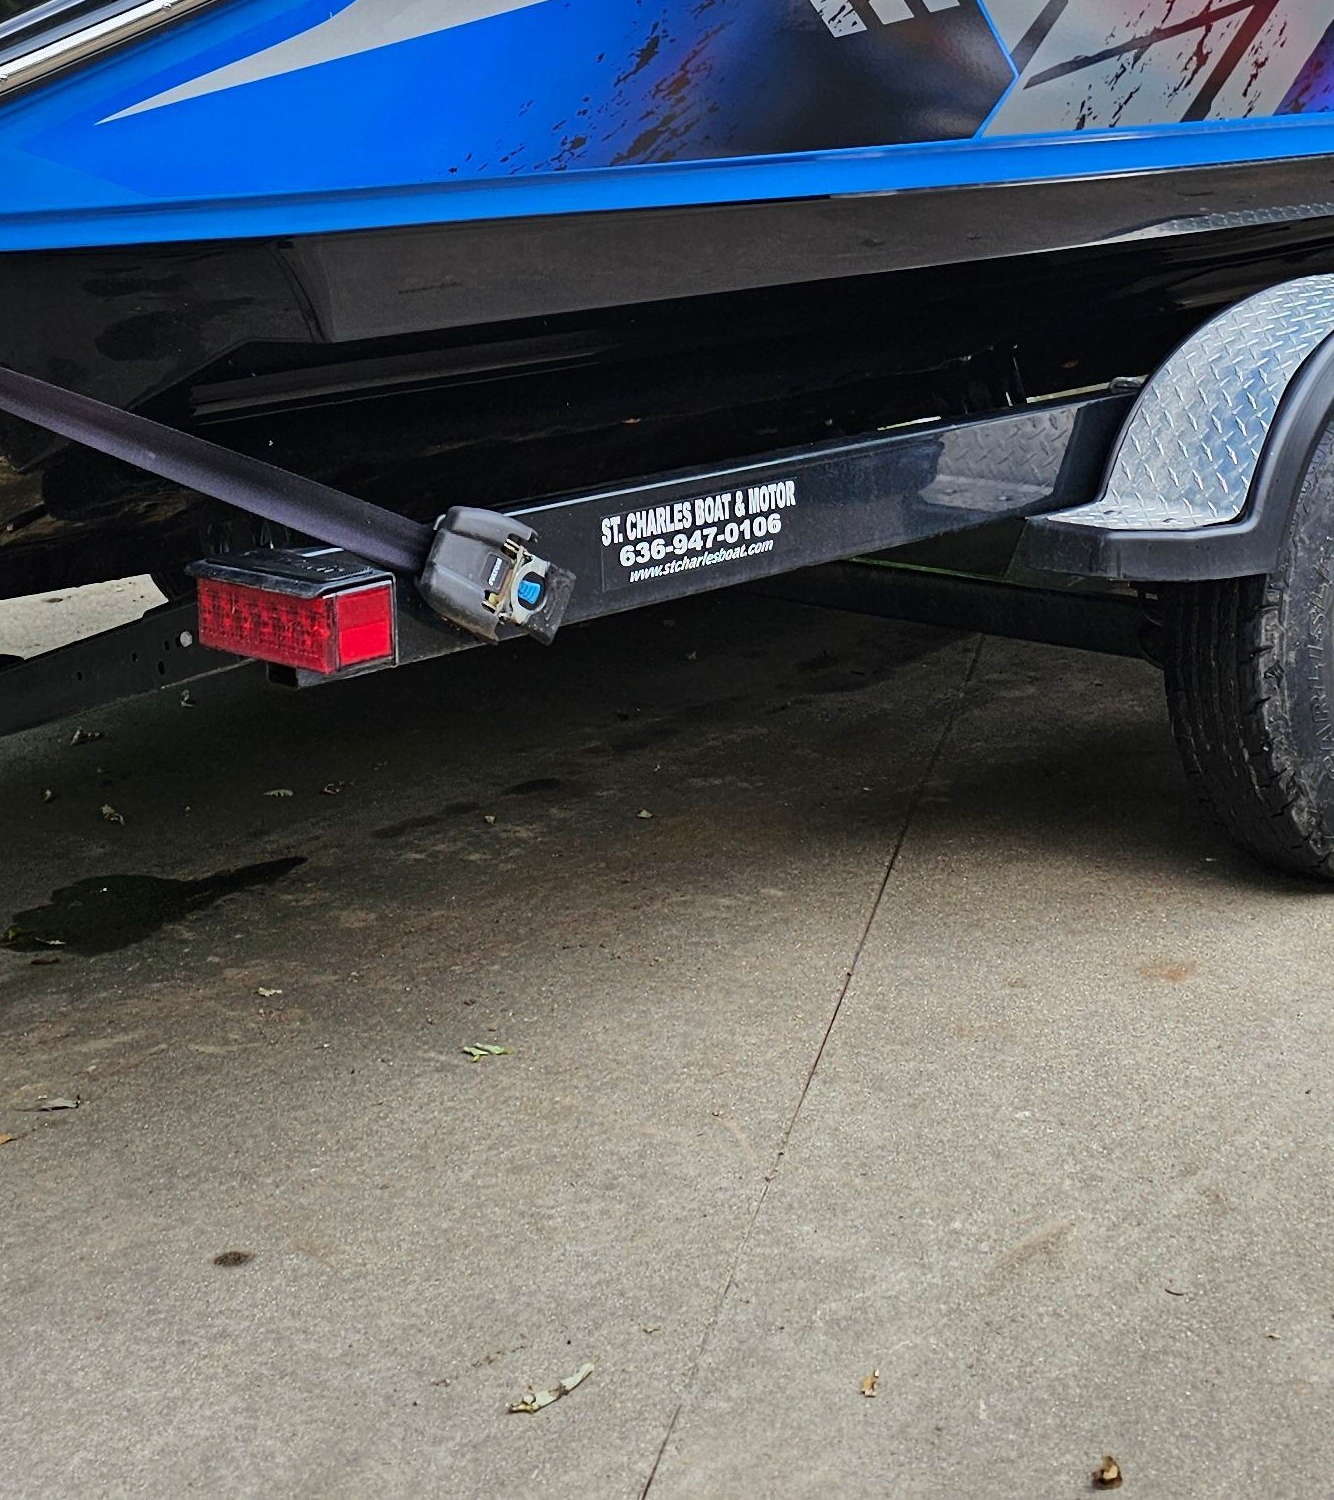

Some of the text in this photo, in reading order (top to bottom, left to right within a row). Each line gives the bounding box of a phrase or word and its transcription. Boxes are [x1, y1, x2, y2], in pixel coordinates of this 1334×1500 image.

[601, 480, 796, 547] ST. CHARLES BOAT & MOTOR
[618, 513, 783, 568] 636-947-0106
[629, 538, 774, 583] www.stcharlesboat.com
